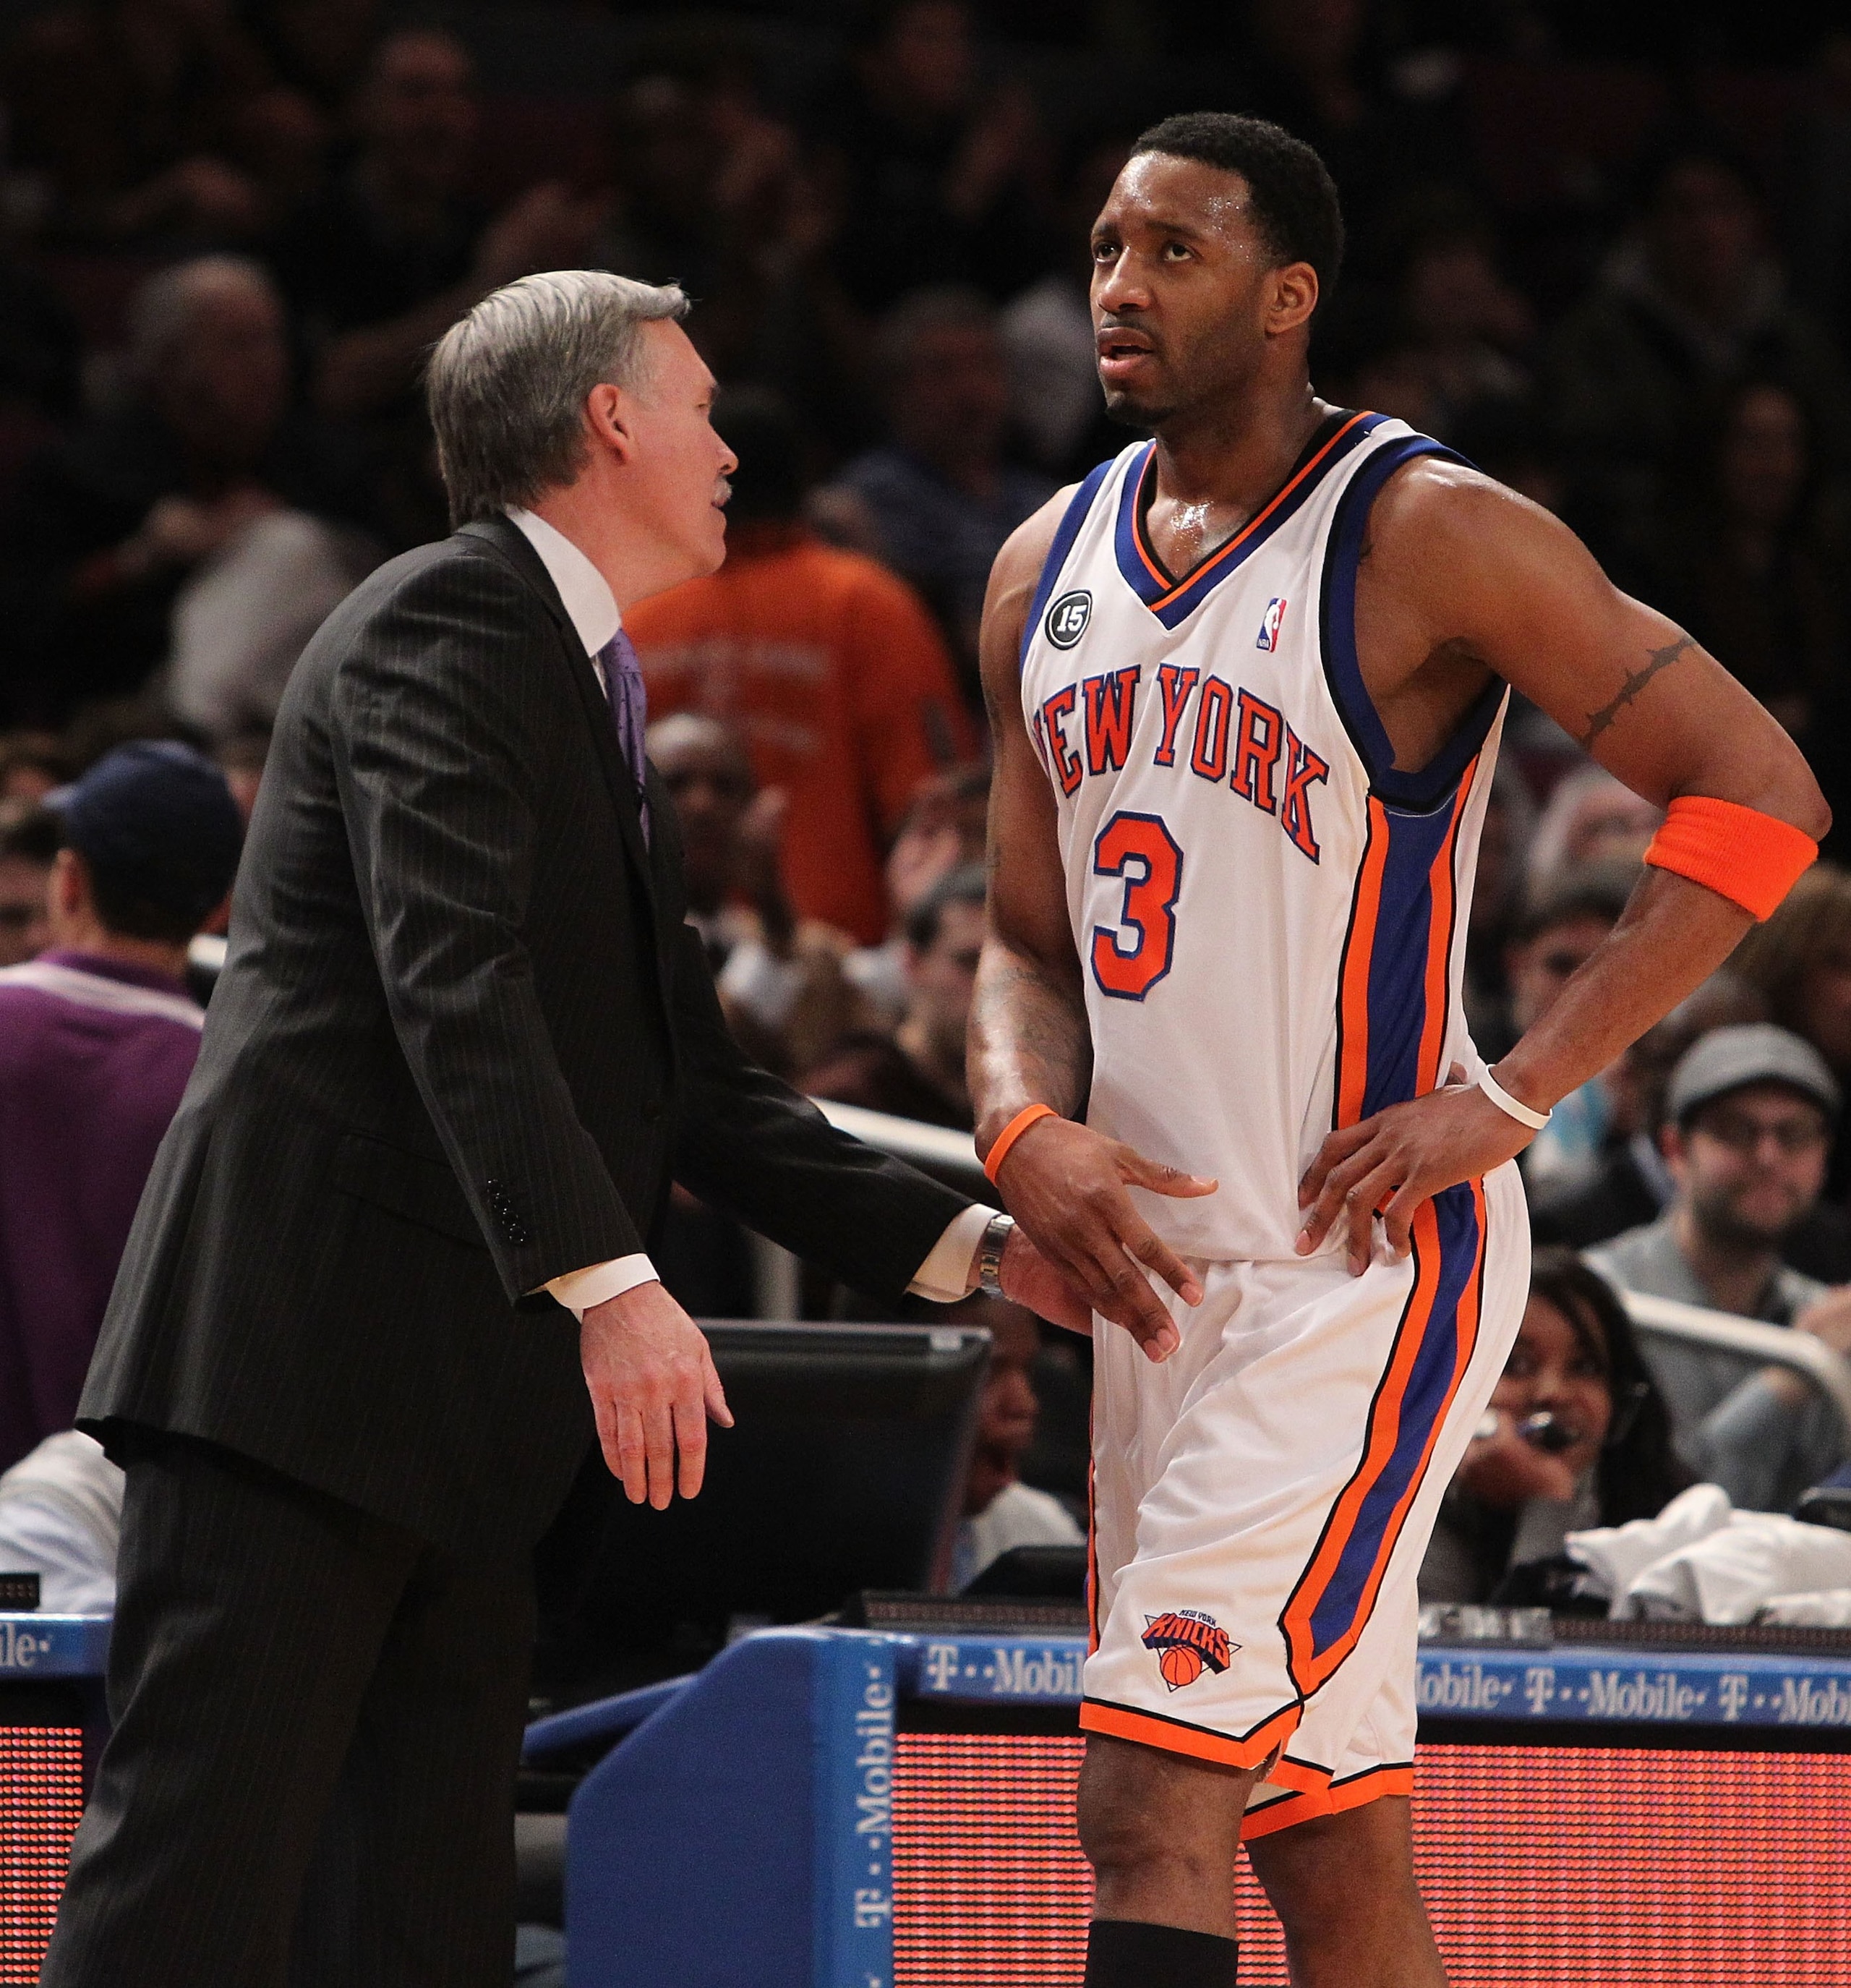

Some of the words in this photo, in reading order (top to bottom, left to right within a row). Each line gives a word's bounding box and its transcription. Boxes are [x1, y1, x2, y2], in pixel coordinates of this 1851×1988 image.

[1056, 604, 1087, 632] 15
[1153, 662, 1329, 865] YORK
[1090, 810, 1184, 1002] 3
[1141, 1612, 1230, 1672] KNICKS
[1179, 1609, 1197, 1618] NEW
[1198, 1611, 1216, 1627] YORK
